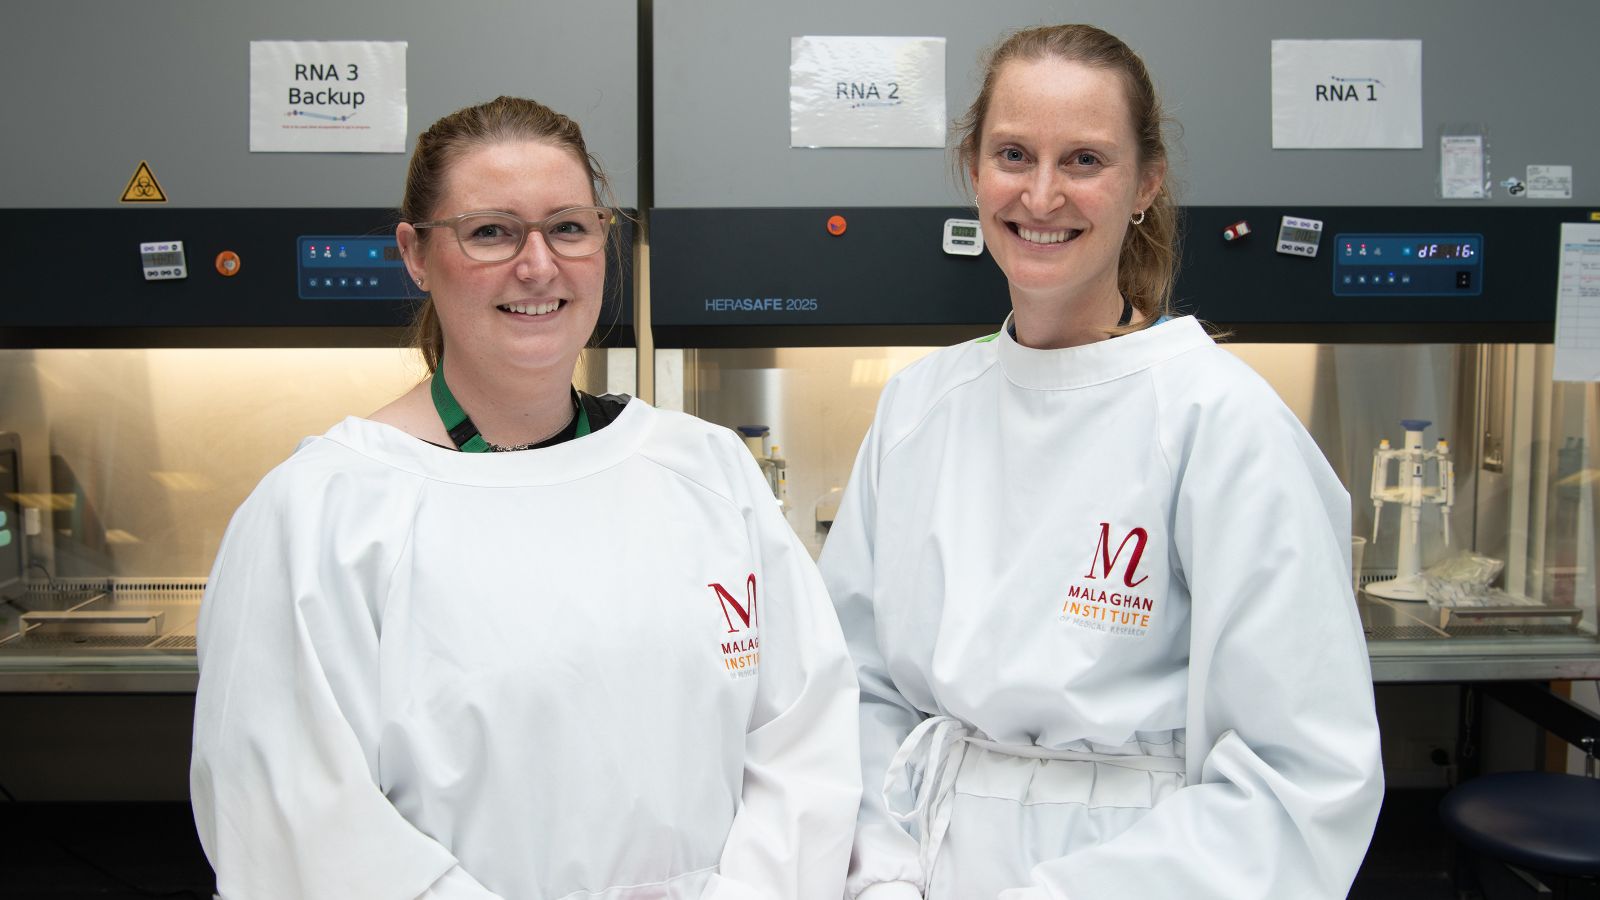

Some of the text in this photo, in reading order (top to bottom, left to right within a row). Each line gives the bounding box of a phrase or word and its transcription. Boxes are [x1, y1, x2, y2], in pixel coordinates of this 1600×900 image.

[295, 64, 359, 81] RNA 3
[289, 88, 365, 109] Backup
[836, 82, 900, 100] RNA 2
[1316, 85, 1377, 101] RNA 1
[705, 299, 818, 311] HERASAFE 2025
[1084, 523, 1148, 587] M
[1068, 586, 1153, 611] MALAGHAN
[1063, 601, 1150, 627] INSTITUTE
